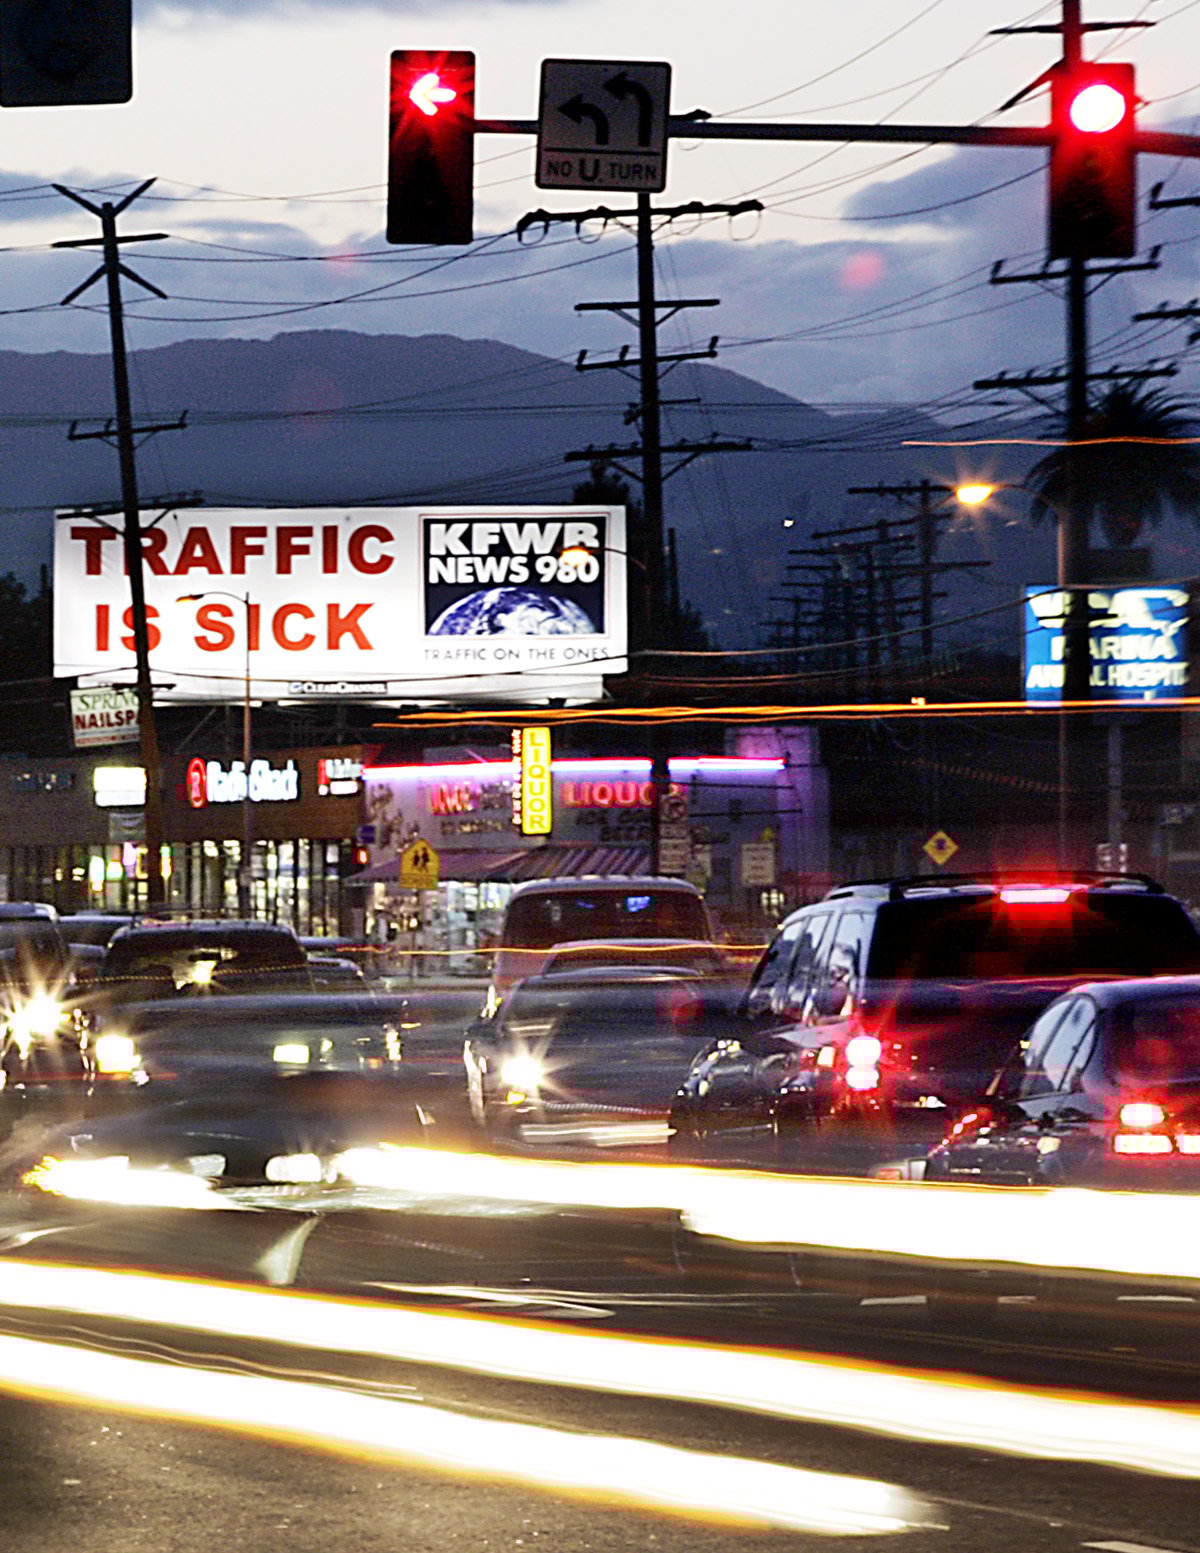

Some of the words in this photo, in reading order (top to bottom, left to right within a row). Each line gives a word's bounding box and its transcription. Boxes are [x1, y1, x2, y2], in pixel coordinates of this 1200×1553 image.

[548, 160, 573, 177] NO
[579, 158, 600, 182] U
[609, 163, 656, 180] TURN
[71, 524, 395, 577] TRAFFIC
[430, 522, 600, 556] KFWB
[428, 556, 530, 584] NEWS
[535, 555, 600, 584] 980
[96, 603, 163, 653] IS
[195, 602, 376, 653] SICK
[425, 648, 487, 662] TRAFFIC
[494, 647, 520, 661] ON
[529, 648, 556, 661] THE
[563, 646, 610, 662] ONES
[528, 732, 546, 830] LIQUOR
